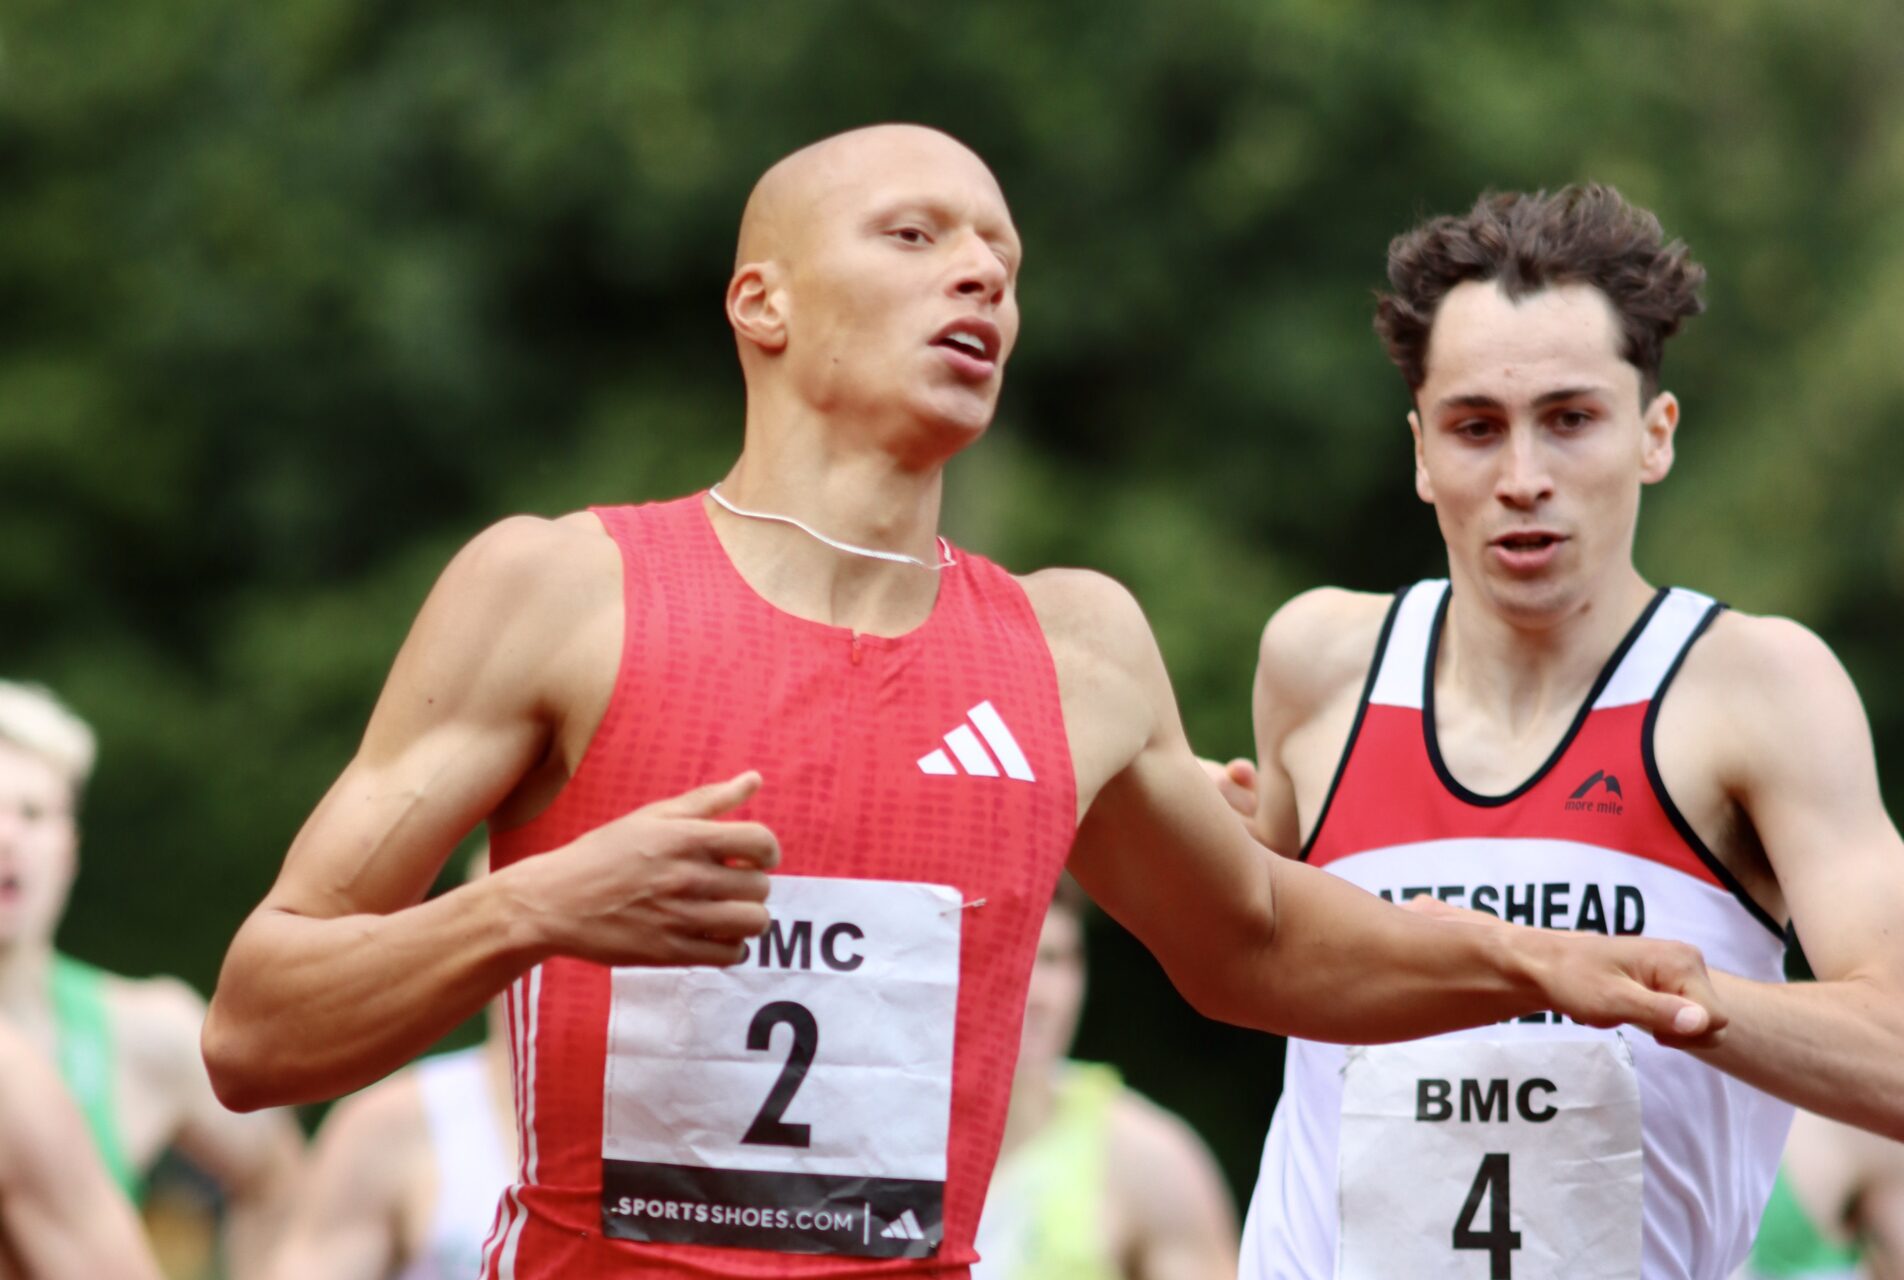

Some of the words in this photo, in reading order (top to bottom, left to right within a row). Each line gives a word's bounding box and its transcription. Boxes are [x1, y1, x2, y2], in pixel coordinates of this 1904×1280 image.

[1565, 801, 1593, 811] more
[1597, 801, 1623, 815] mile
[738, 919, 865, 972] MC
[740, 1000, 818, 1149] 2
[1415, 1078, 1559, 1123] BMC
[618, 1197, 853, 1232] SPORTSSHOES.COM
